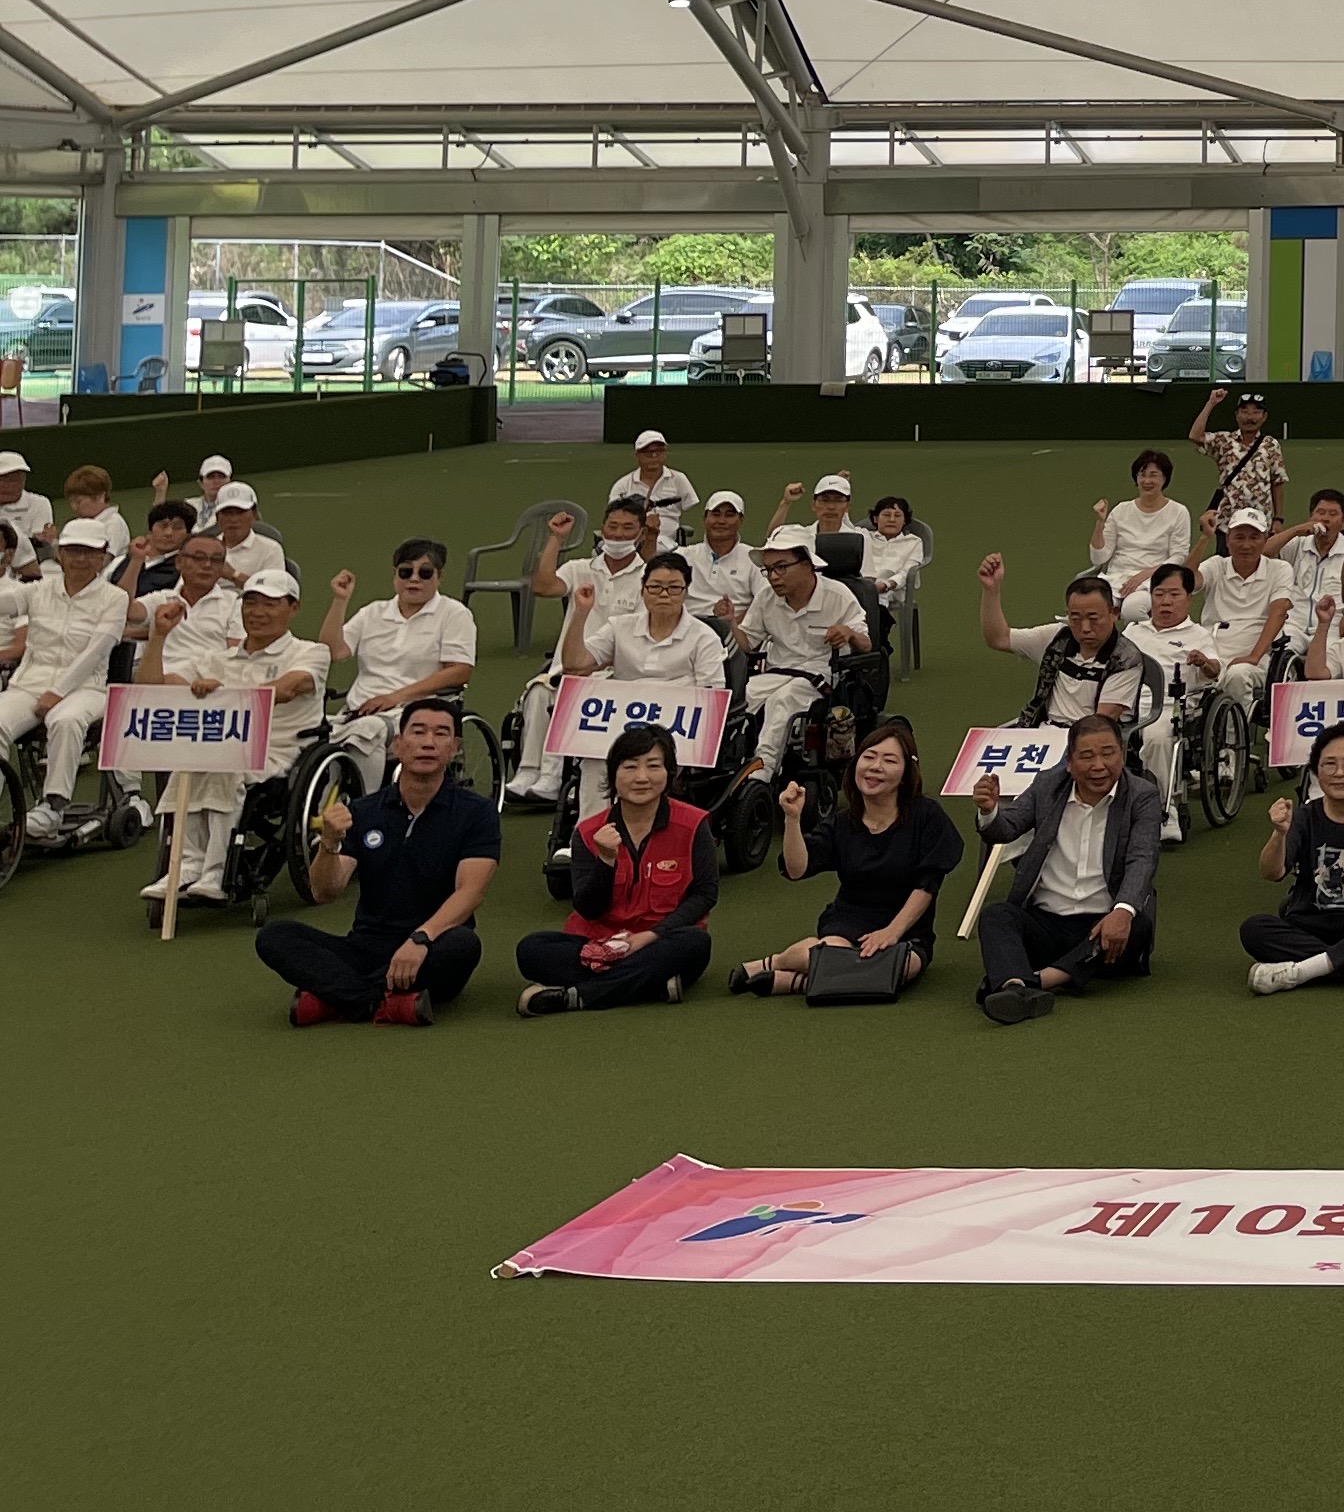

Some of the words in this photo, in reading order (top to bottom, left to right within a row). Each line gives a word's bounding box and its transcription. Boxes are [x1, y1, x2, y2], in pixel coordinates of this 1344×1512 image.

[123, 707, 251, 742] 서울특별시
[578, 697, 703, 740] 안양시
[976, 744, 1050, 774] 부천
